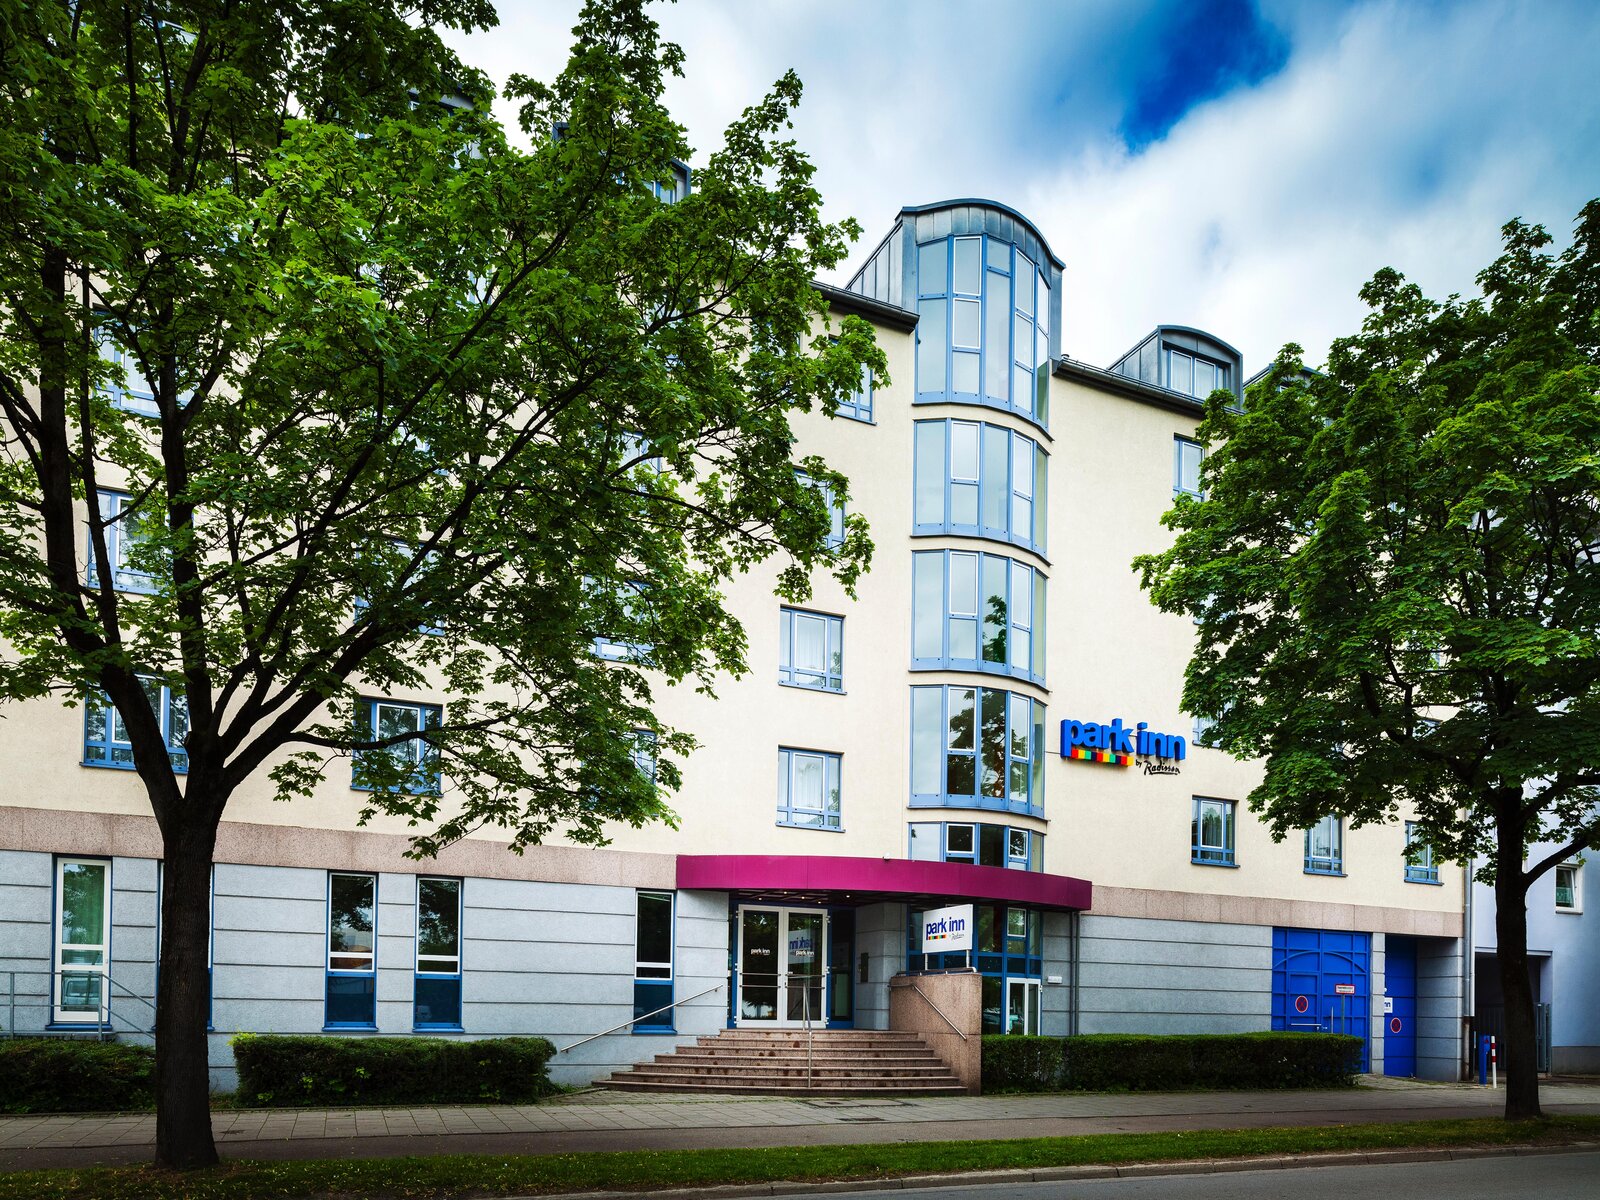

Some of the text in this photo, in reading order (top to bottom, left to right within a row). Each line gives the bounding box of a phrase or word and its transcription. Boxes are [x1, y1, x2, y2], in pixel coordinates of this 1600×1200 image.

[1061, 718, 1186, 760] park inn
[1136, 759, 1180, 775] by Radisson
[926, 918, 947, 940] park
[949, 917, 965, 932] inn
